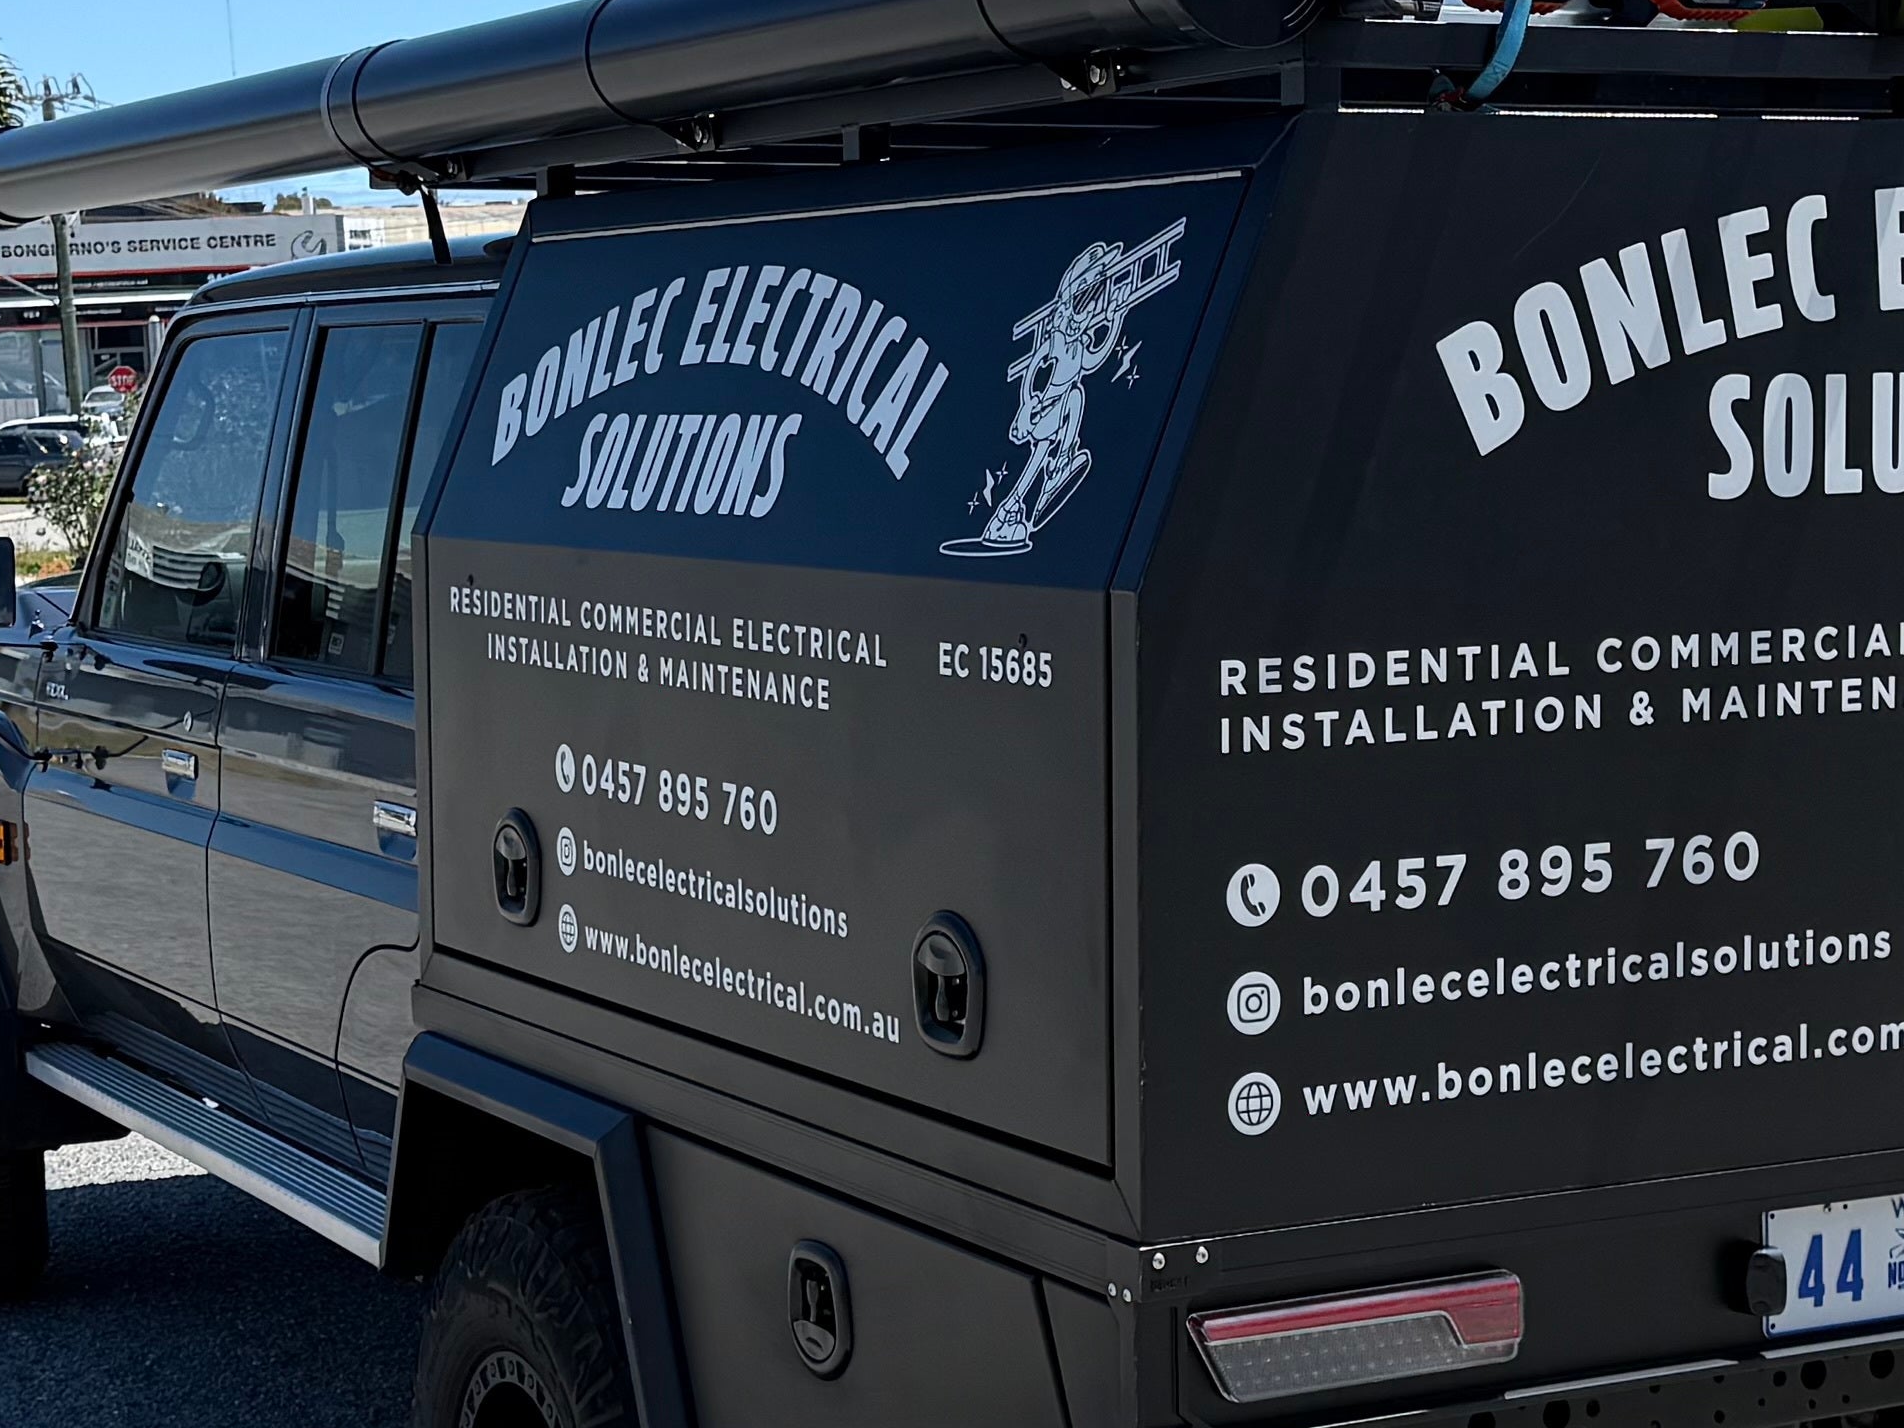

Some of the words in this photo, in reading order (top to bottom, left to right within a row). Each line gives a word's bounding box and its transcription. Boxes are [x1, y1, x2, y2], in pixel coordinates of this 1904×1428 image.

[1, 239, 122, 258] BONGIRNO'S
[127, 236, 201, 253] SERVICE
[206, 233, 277, 248] CENTRE
[1435, 194, 1837, 458] BONLEC
[492, 278, 686, 466] BONLEC
[679, 265, 949, 481] ELECTRICAL
[561, 413, 802, 519] SOLUTIONS
[450, 586, 572, 629] RESIDENTIAL
[579, 600, 722, 648] COMMERCIAL
[732, 618, 888, 669] ELECTRICAL
[938, 642, 970, 678] EC
[978, 645, 1053, 689] 15685
[1219, 639, 1571, 697] RESIDENTIAL
[487, 633, 629, 680] INSTALLATION
[637, 656, 650, 683] &
[659, 657, 831, 713] MAINTENANCE
[1220, 693, 1602, 755] INSTALLATION
[1628, 690, 1655, 728] &
[582, 754, 647, 807] 0457
[658, 769, 710, 821] 895
[722, 782, 778, 836] 760
[583, 840, 849, 939] bonlecelectricalsolutions
[1301, 853, 1468, 918] 0457
[1497, 842, 1614, 901] 895
[1645, 831, 1761, 889] 760
[584, 923, 900, 1045] www.bonlecelectrical.com.au
[1302, 928, 1892, 1015] bonlecelectricalsolutions
[1798, 1228, 1864, 1309] 44
